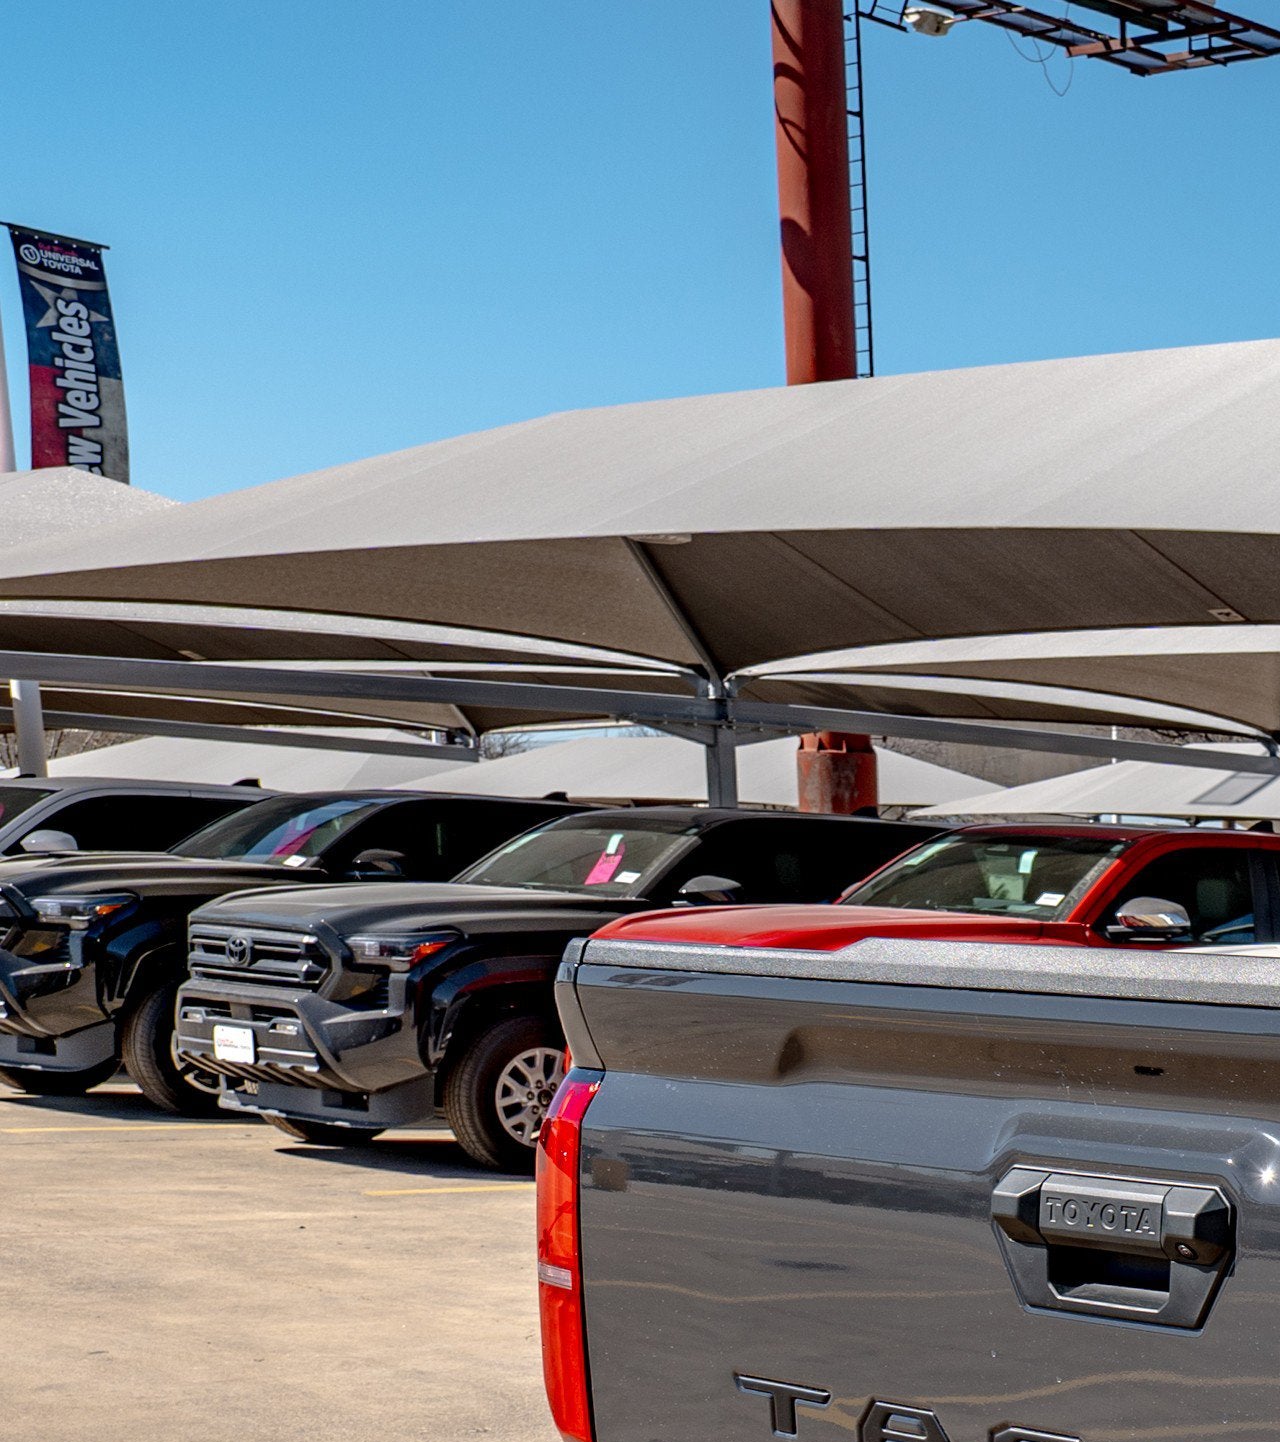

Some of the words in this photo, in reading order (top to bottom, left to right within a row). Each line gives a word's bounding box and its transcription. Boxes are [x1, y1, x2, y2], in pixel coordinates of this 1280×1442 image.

[40, 249, 99, 270] UNIVERSAL
[42, 258, 82, 275] TOYOTA
[52, 299, 101, 428] Vehicles
[1045, 1196, 1156, 1235] TOYOTA
